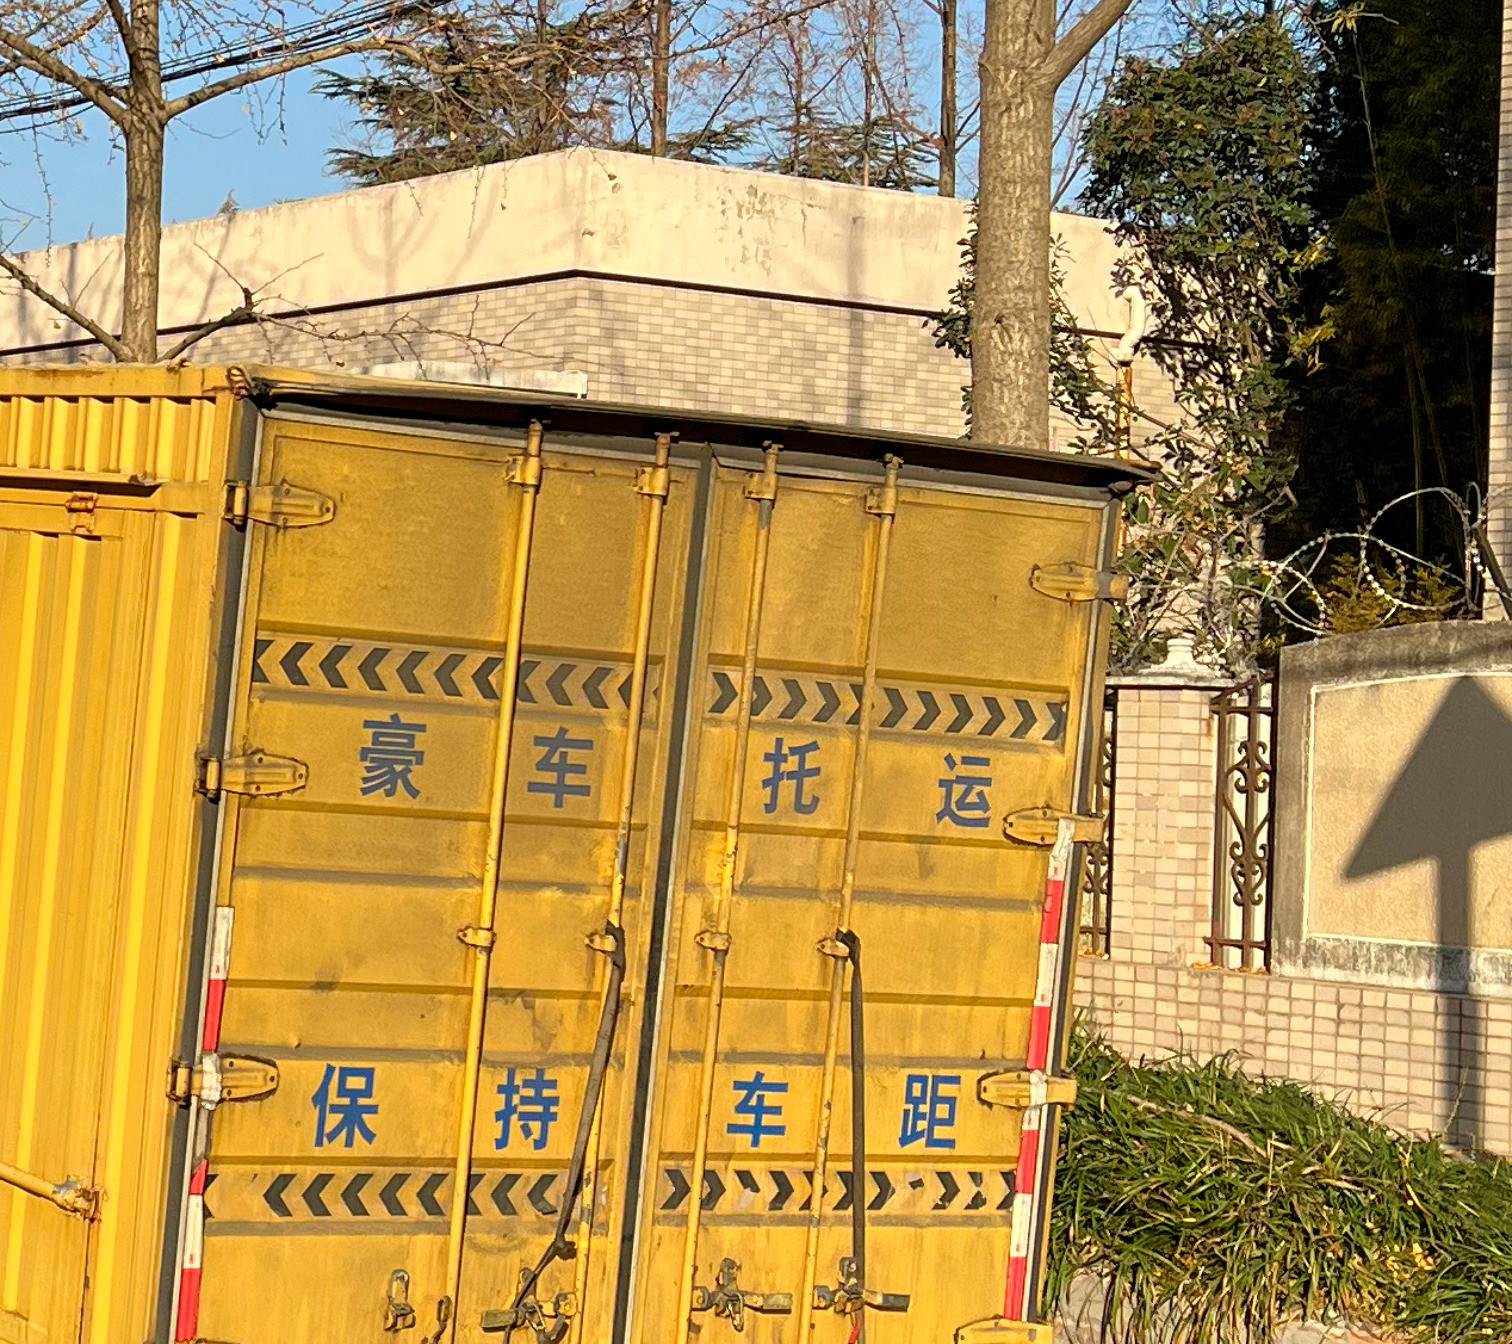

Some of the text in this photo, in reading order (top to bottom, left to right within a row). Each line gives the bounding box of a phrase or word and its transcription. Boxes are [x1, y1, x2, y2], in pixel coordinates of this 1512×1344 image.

[358, 714, 992, 828] 豪车托运
[310, 1062, 961, 1151] 保持车距
